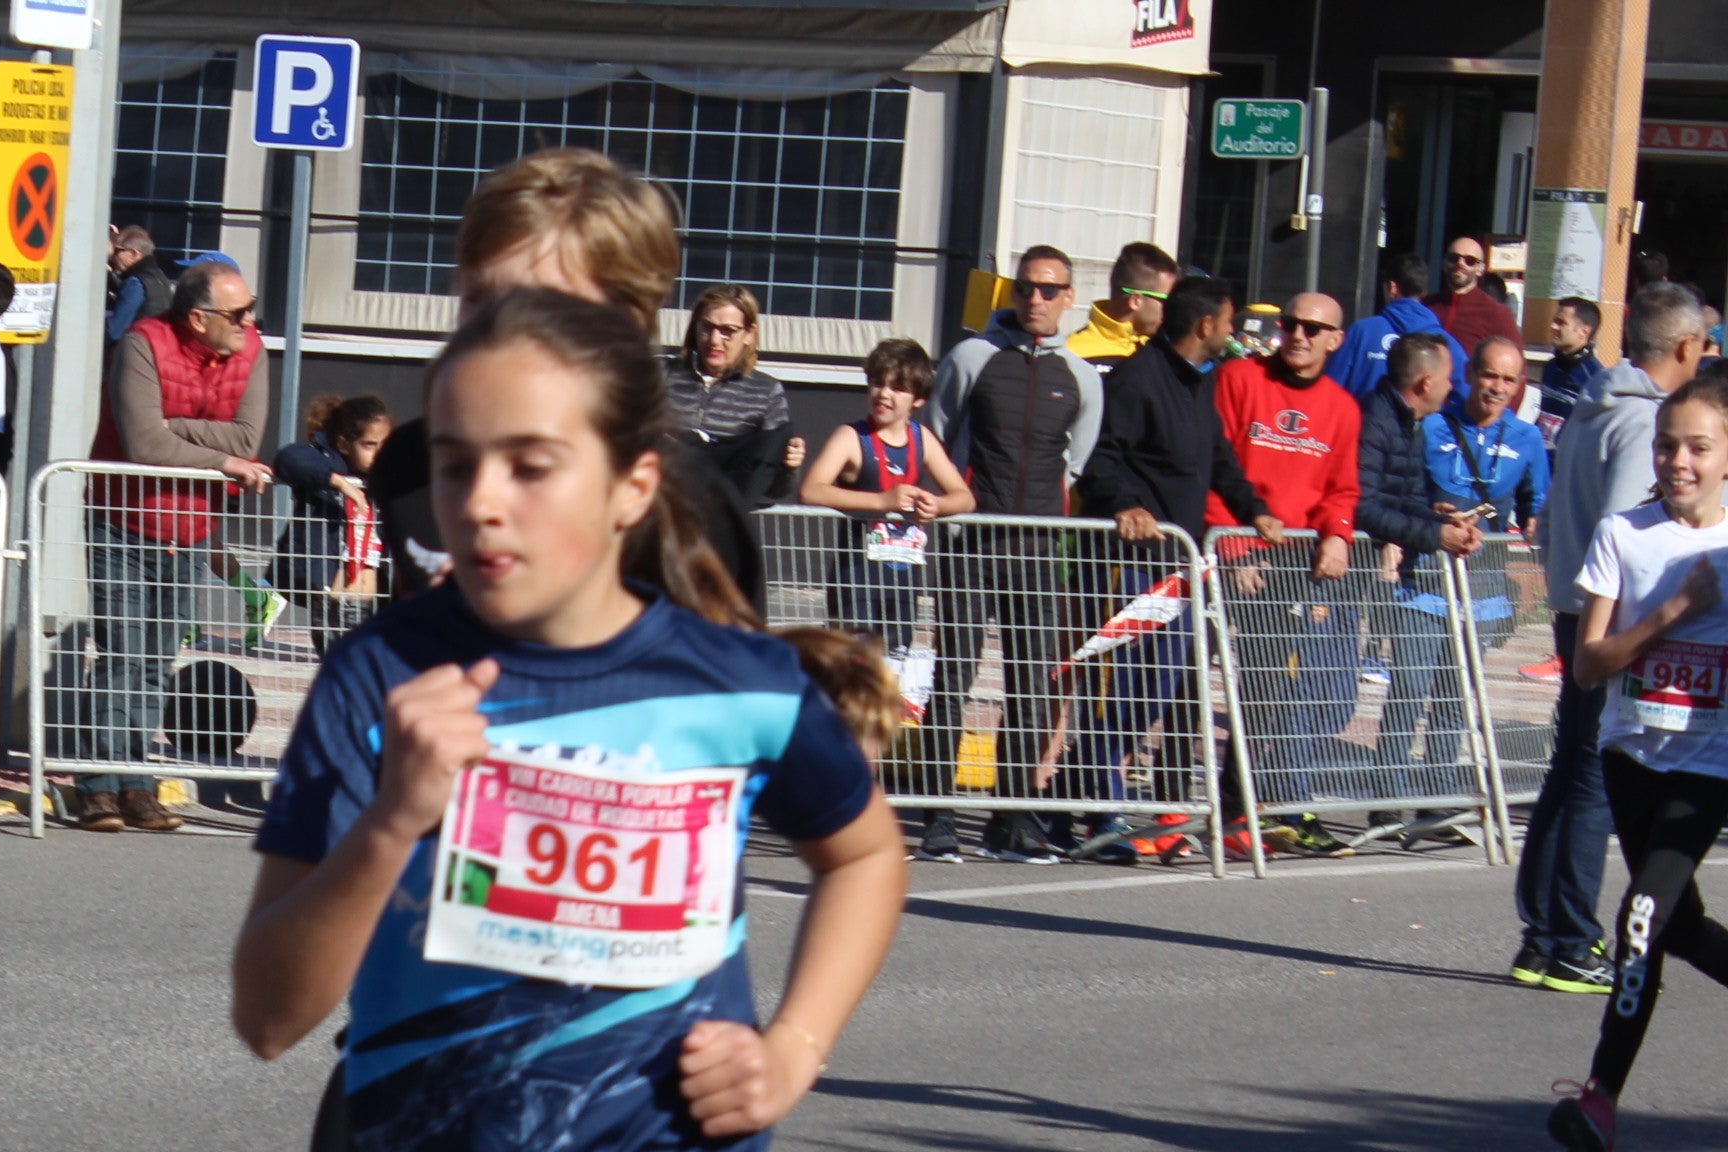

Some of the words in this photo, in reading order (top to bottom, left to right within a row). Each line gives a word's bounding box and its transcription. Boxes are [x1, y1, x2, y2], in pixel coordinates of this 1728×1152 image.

[272, 50, 334, 134] P
[1245, 103, 1291, 120] Pasaje
[1256, 122, 1274, 134] del
[1221, 134, 1298, 154] Auditorio
[1653, 662, 1713, 694] 984
[621, 784, 694, 808] POPULAR
[526, 823, 662, 898] 961
[477, 917, 686, 961] meetingpoint
